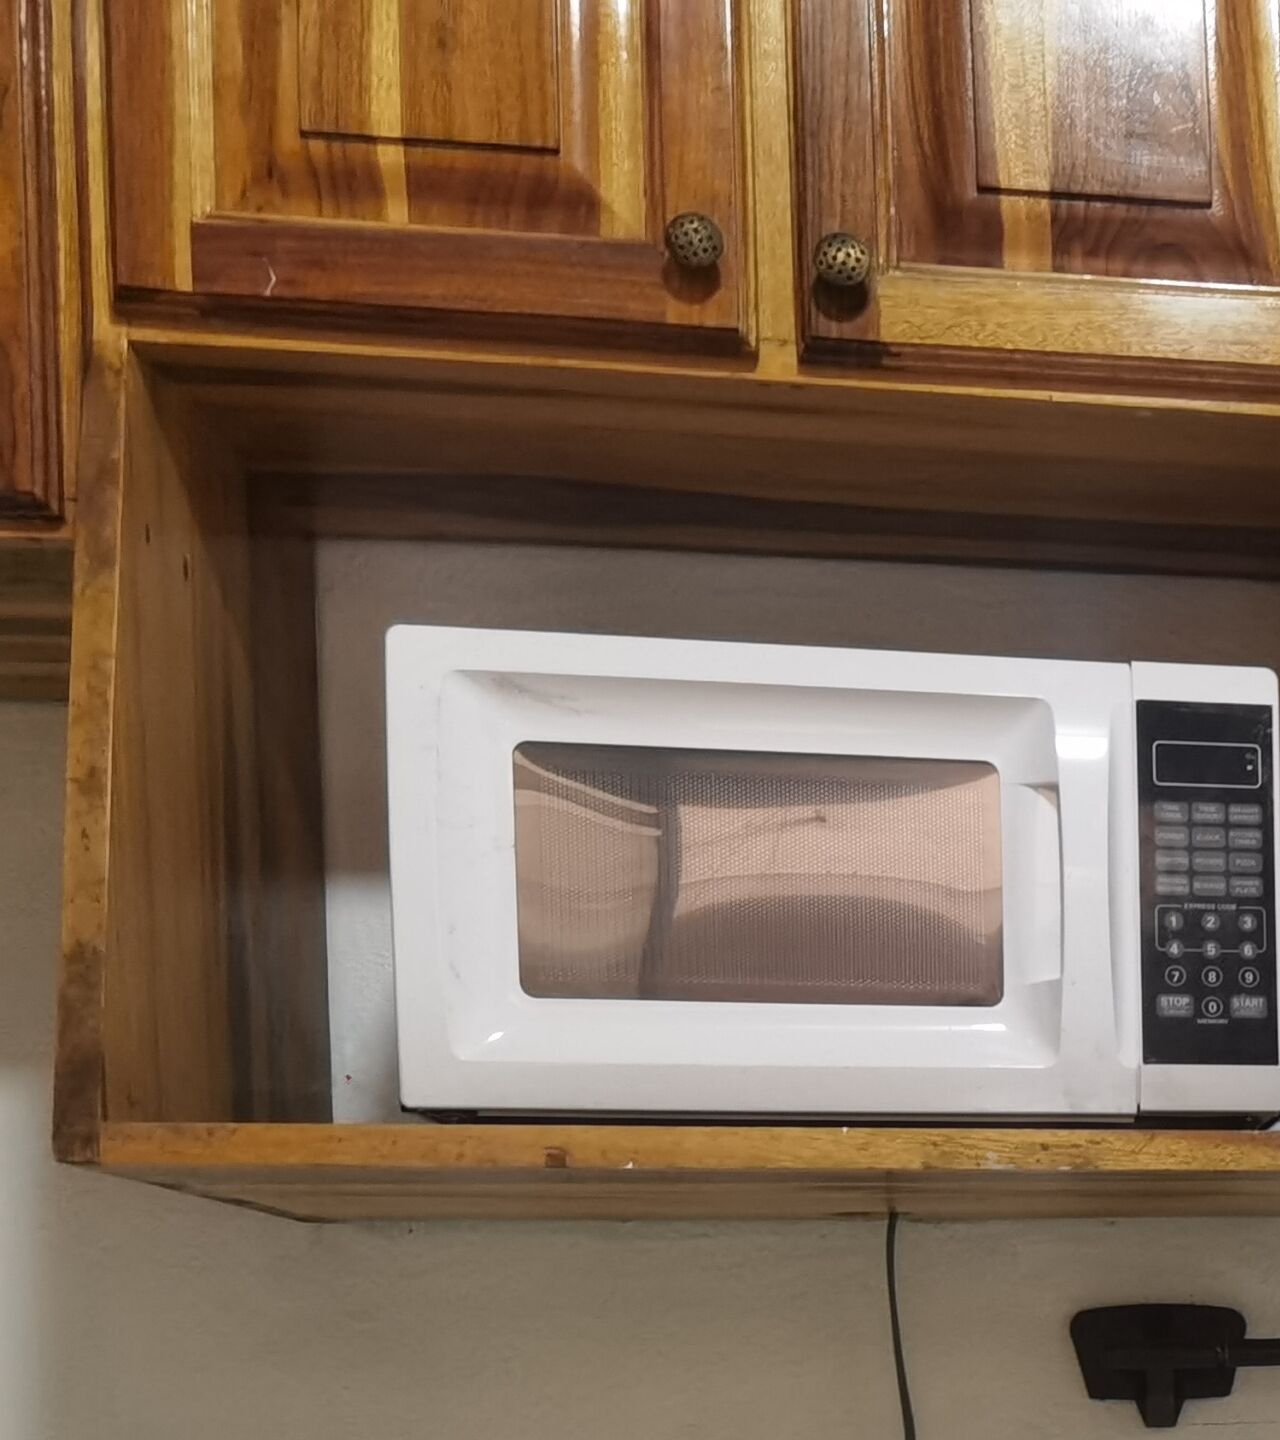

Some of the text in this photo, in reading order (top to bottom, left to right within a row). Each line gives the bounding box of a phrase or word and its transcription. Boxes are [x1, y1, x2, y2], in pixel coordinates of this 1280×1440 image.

[1169, 915, 1177, 928] 1
[1205, 916, 1215, 928] 2
[1243, 916, 1252, 929] 3
[1169, 943, 1178, 955] 4
[1206, 944, 1216, 956] 5
[1243, 944, 1253, 956] 6
[1171, 971, 1180, 983] 7
[1207, 971, 1217, 983] 8
[1244, 971, 1254, 984] 9
[1160, 997, 1190, 1007] STOP
[1208, 1001, 1217, 1013] 0
[1233, 997, 1264, 1008] START
